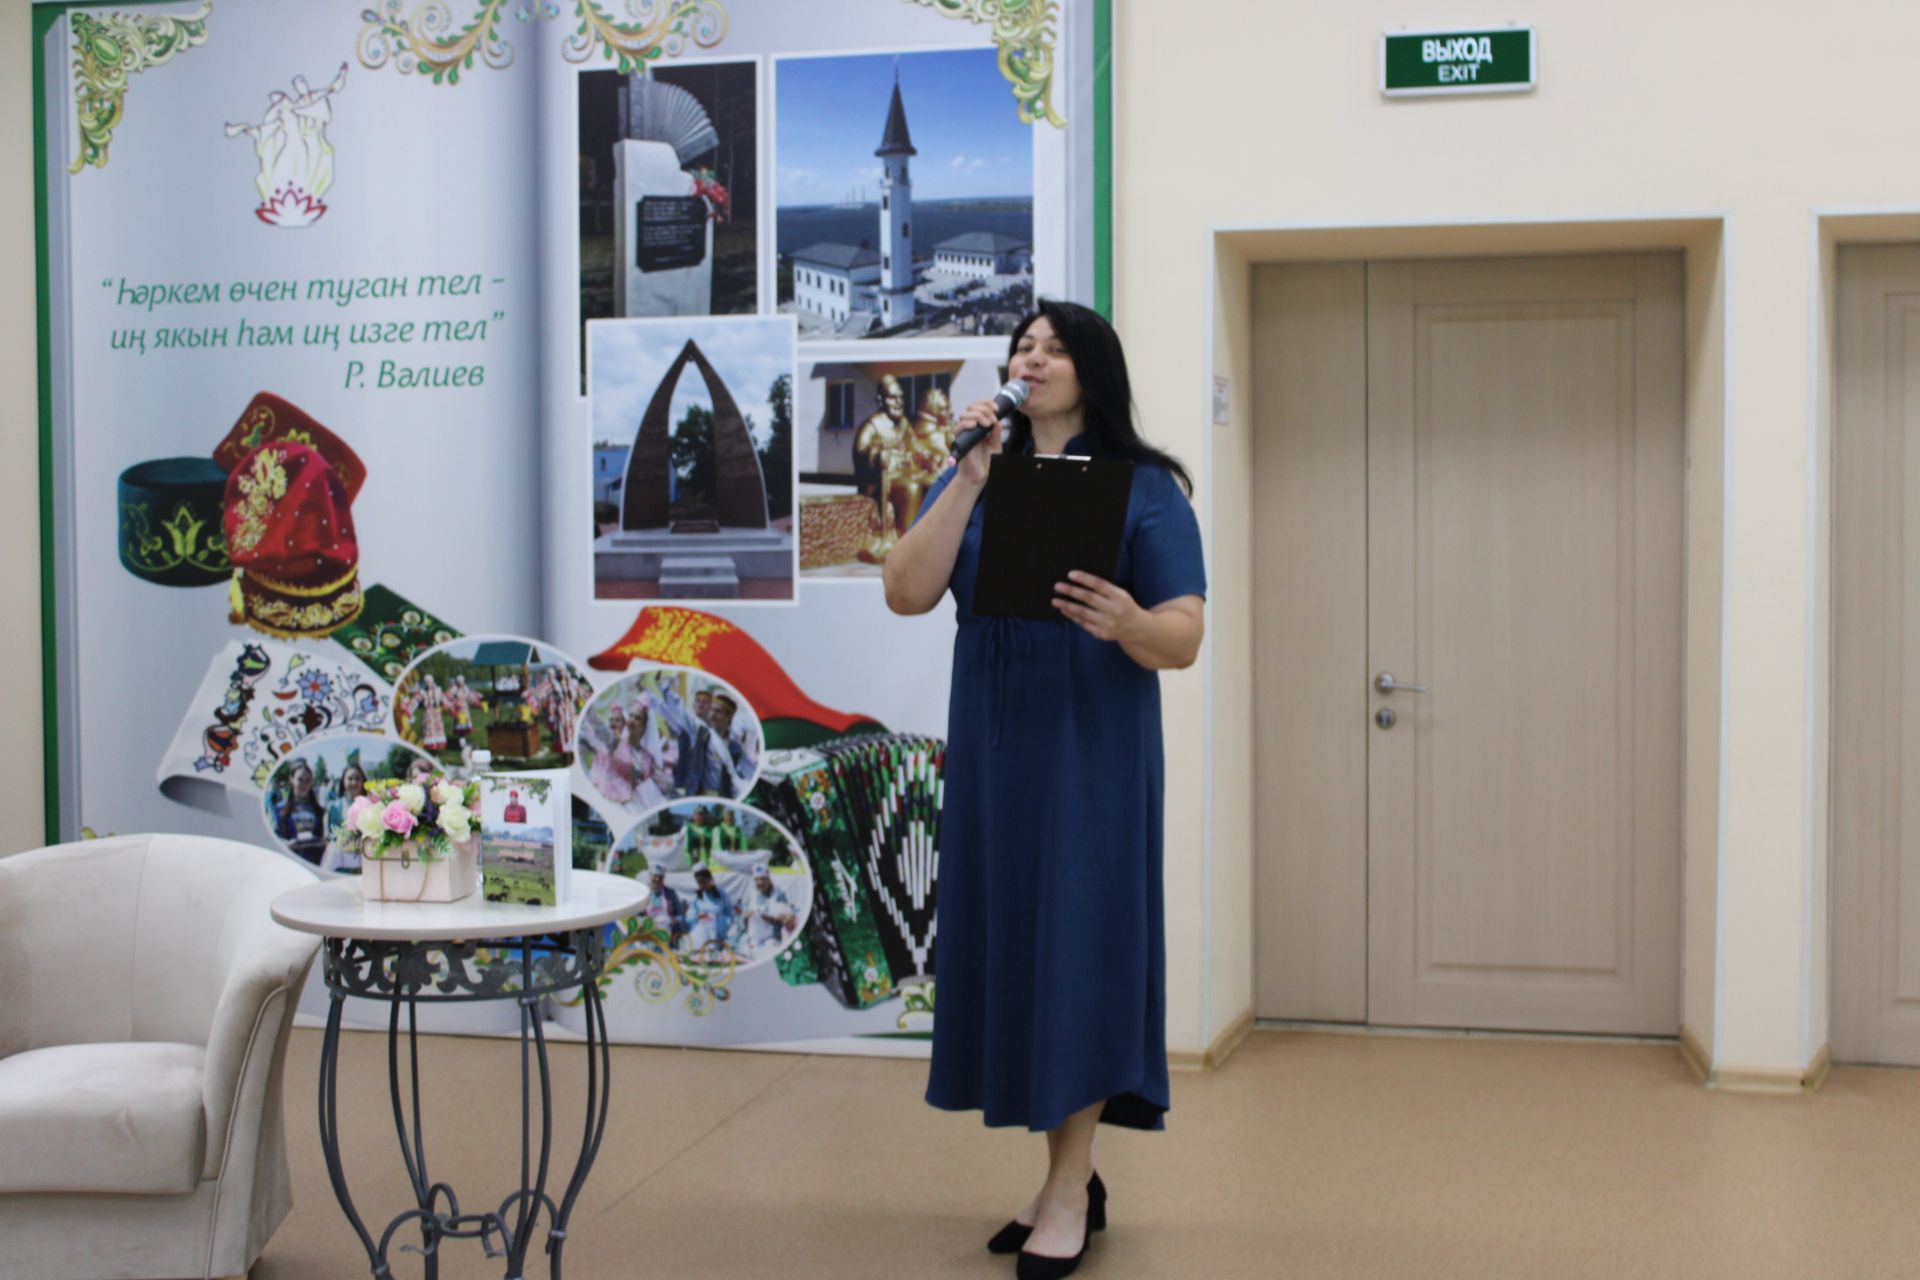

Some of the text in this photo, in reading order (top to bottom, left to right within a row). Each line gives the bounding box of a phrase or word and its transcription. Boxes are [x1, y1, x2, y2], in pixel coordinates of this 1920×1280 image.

[1421, 36, 1493, 64] ВЫХОД
[1437, 63, 1480, 83] EXIT
[228, 279, 301, 303] өчен
[306, 276, 409, 308] туган
[417, 273, 482, 297] тел
[110, 327, 146, 356] иң
[154, 325, 228, 349] якын
[303, 323, 340, 351] иң
[349, 320, 415, 345] изге
[344, 359, 486, 389] Р. Вәлиев
